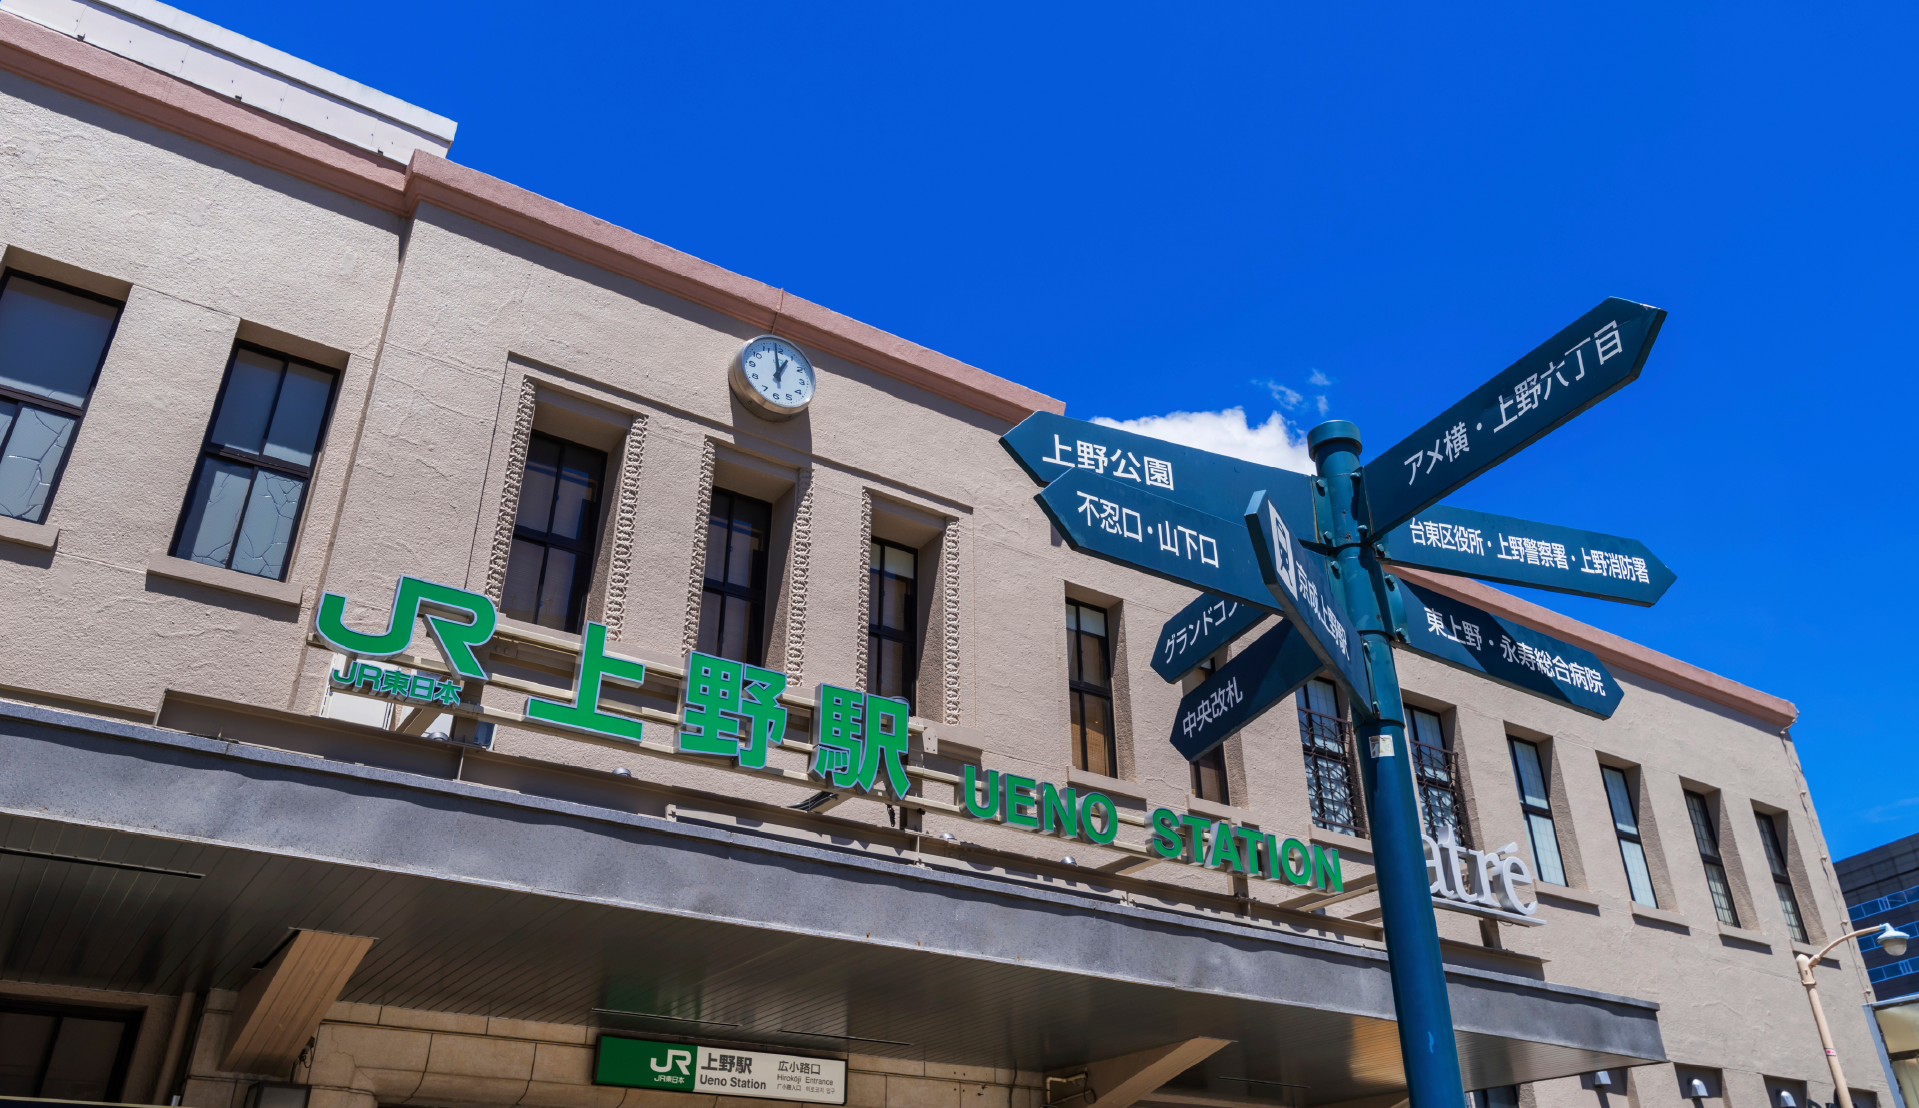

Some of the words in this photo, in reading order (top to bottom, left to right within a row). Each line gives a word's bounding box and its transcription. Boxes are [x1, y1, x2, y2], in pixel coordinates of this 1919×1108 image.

[753, 351, 763, 360] 10
[1404, 320, 1623, 486] アメ横・上野六丁目
[1042, 434, 1174, 491] 上野公園
[1076, 490, 1220, 569] 不忍口・山下口
[1409, 517, 1650, 585] 台東区役所・上野警察署・上野消防署
[315, 574, 496, 682] JR
[1424, 607, 1606, 697] 東上野・永寿総合病院
[331, 660, 462, 706] JR東日本
[526, 620, 909, 799] 上野駅
[1182, 676, 1243, 739] 中央改札
[963, 764, 1119, 845] UENO
[1150, 808, 1344, 893] STATION
[650, 1049, 692, 1075] JR
[654, 1075, 685, 1085] JR東日本
[700, 1053, 753, 1075] 上野駅
[700, 1074, 728, 1087] Ueno
[729, 1076, 767, 1090] Station
[777, 1060, 821, 1075] 広小路口
[805, 1076, 834, 1086] Entrance
